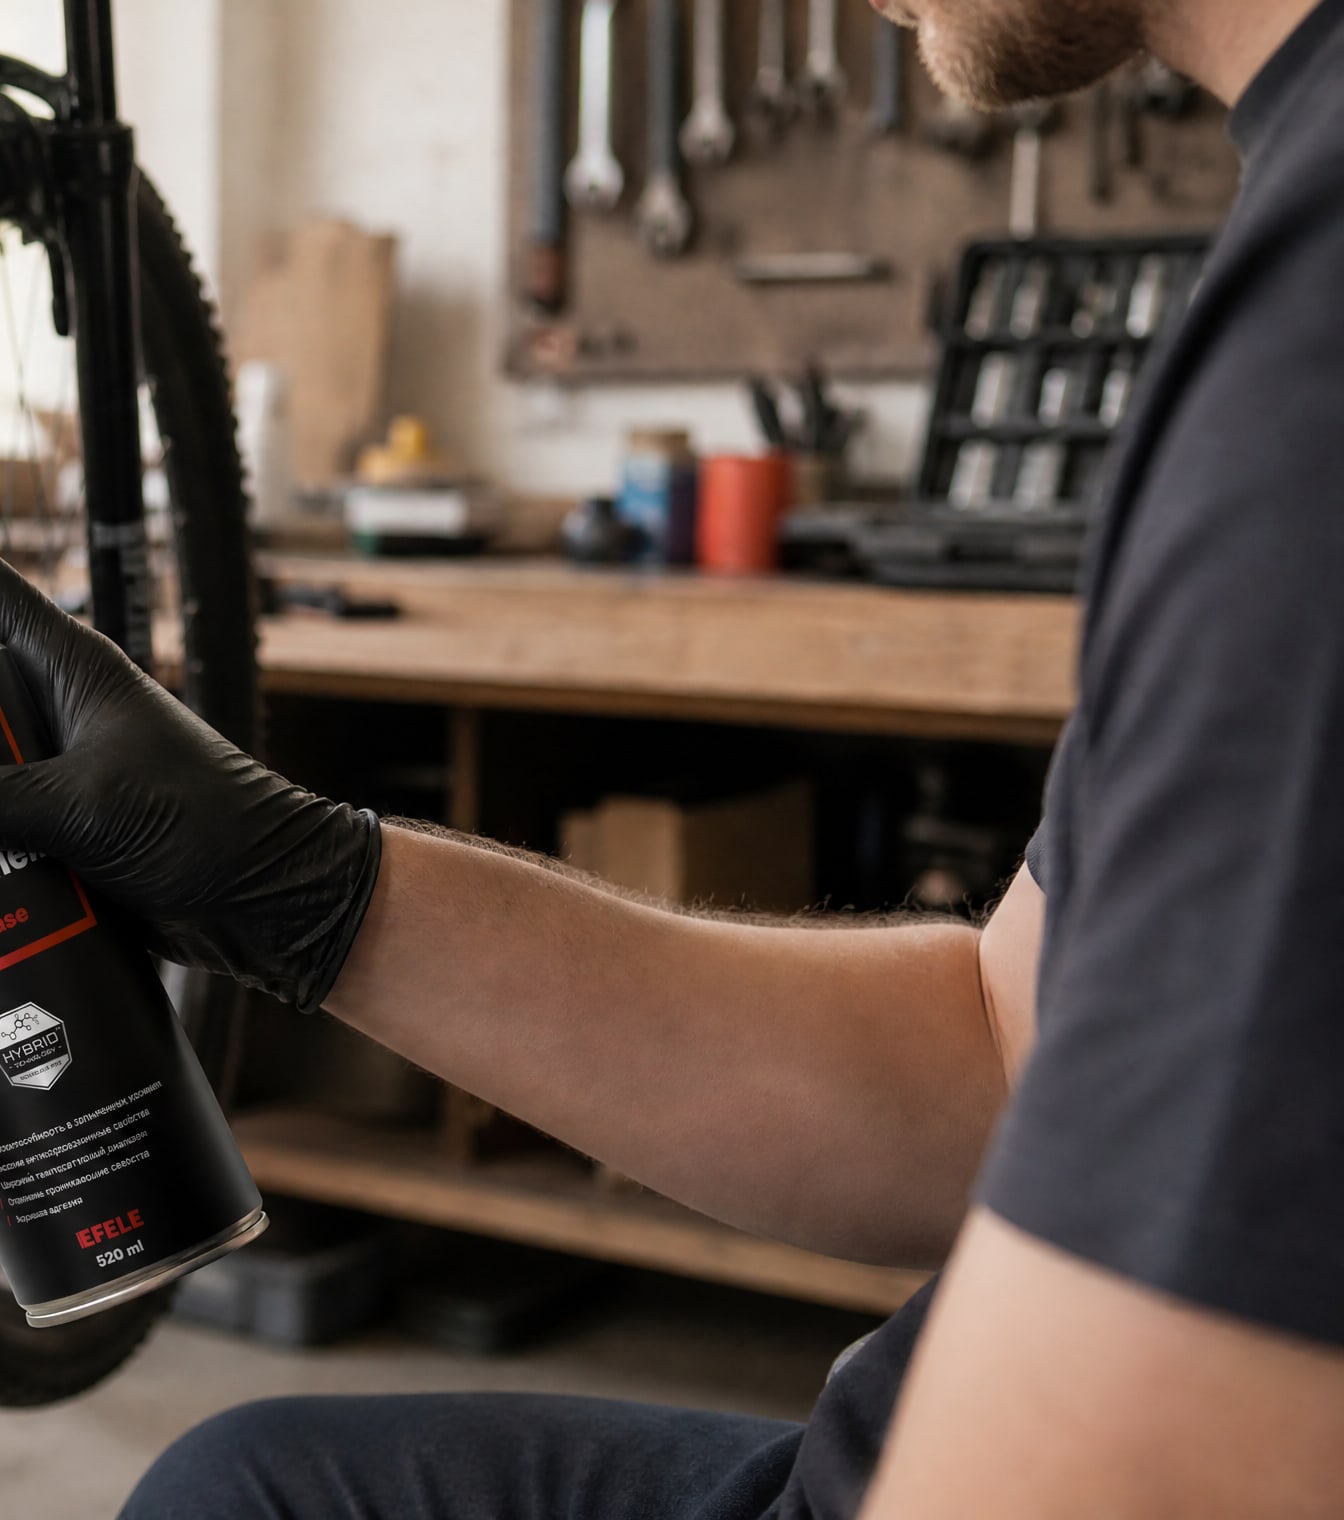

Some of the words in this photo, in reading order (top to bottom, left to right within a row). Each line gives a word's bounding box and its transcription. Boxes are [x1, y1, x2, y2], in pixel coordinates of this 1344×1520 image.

[2, 1031, 59, 1064] HYBRID
[75, 1208, 145, 1249] EFELE
[96, 1248, 124, 1268] 520
[126, 1239, 145, 1256] ml
